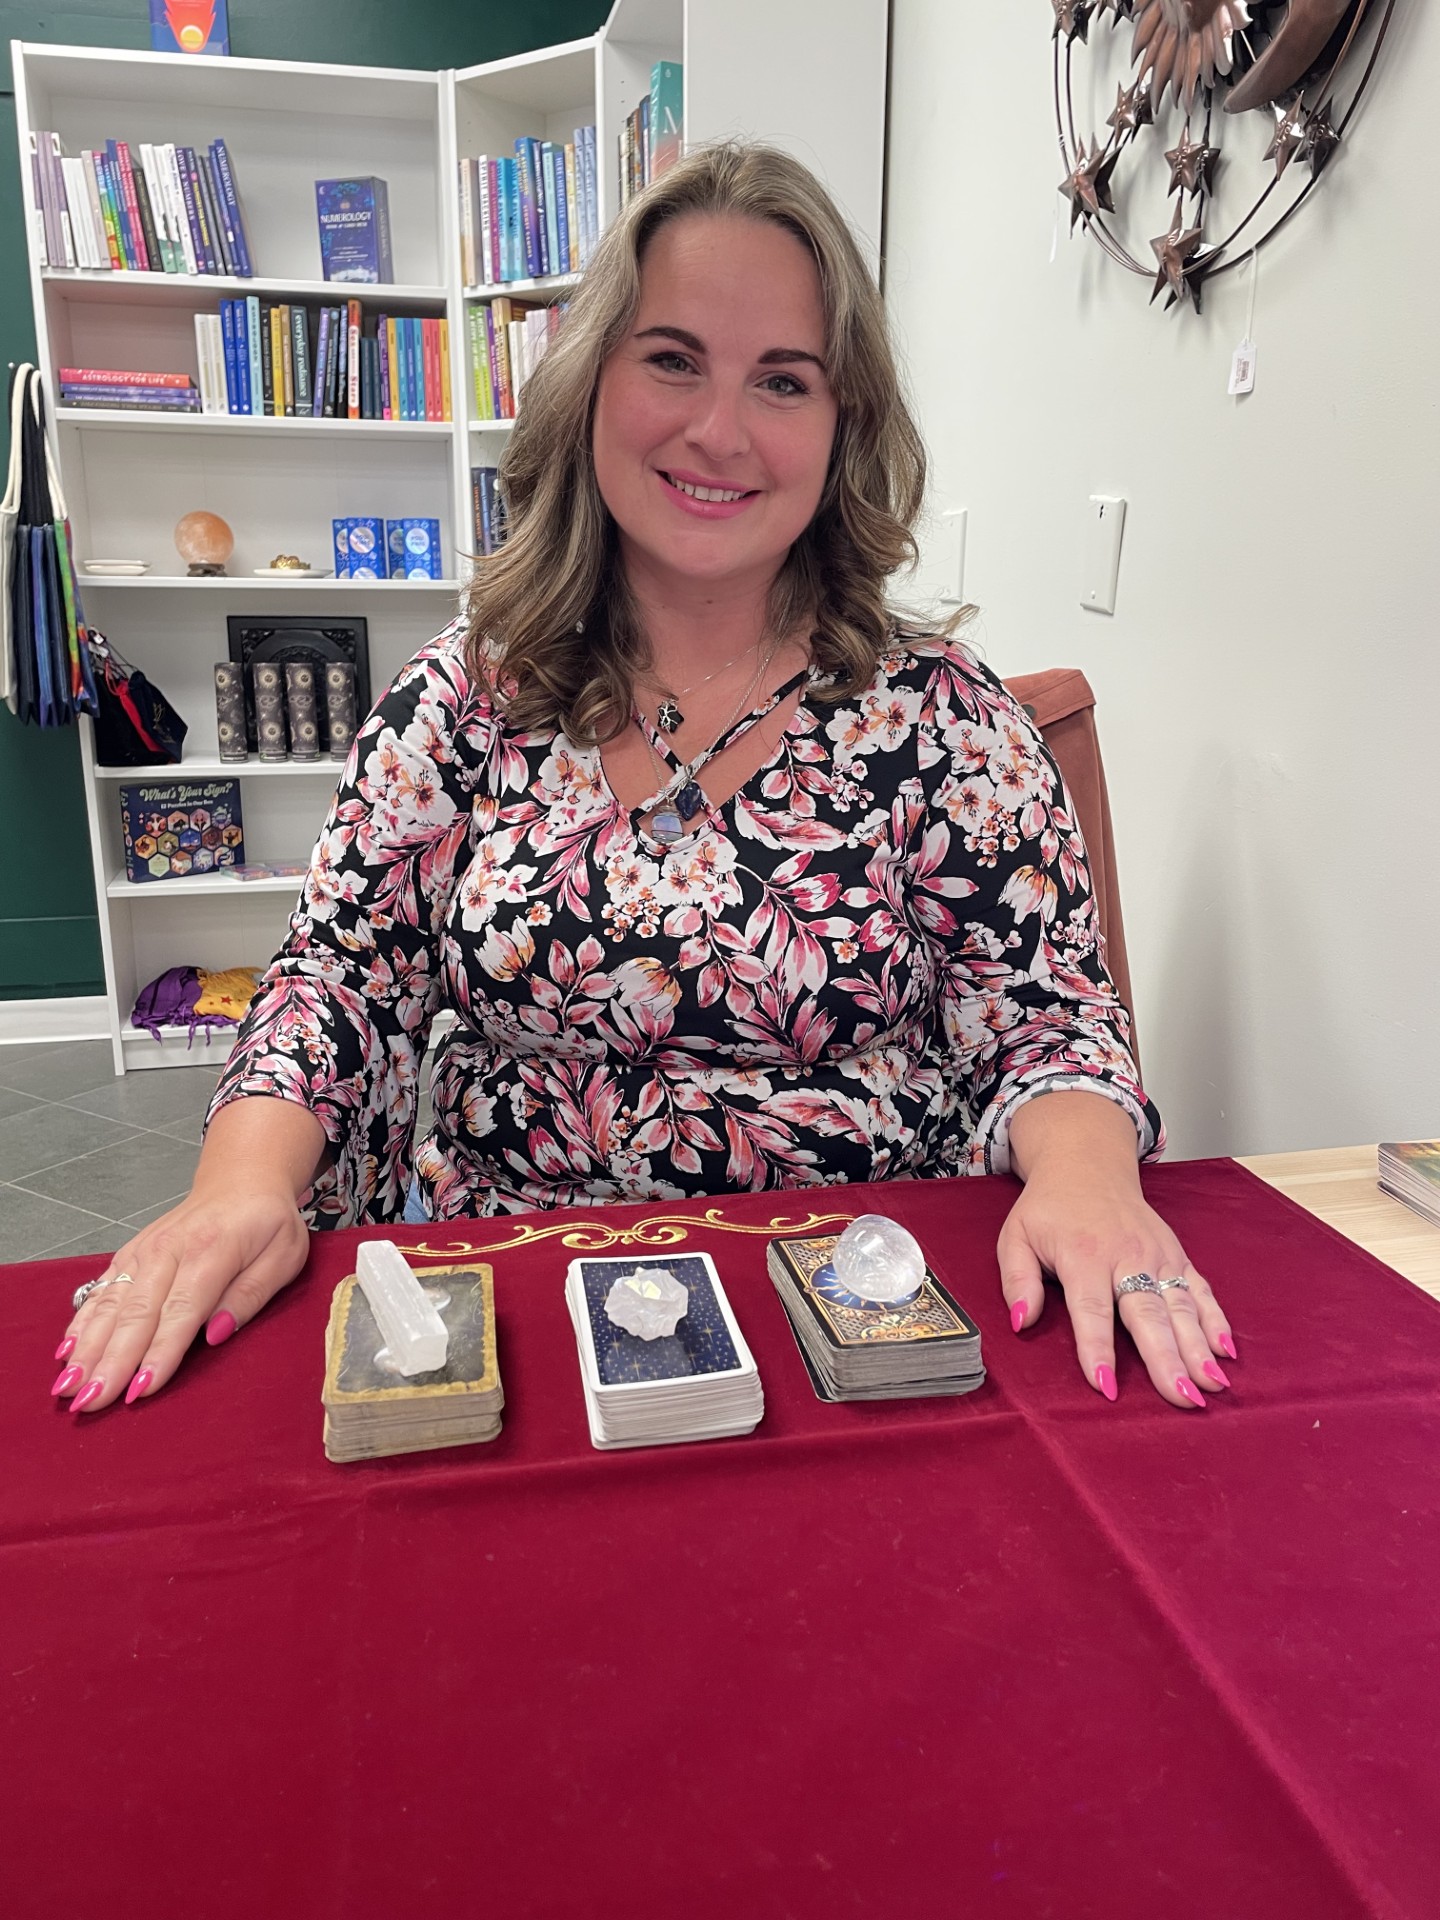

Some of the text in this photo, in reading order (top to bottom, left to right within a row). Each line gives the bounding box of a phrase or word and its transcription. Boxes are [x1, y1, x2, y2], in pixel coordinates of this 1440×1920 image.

[176, 149, 186, 170] LOVE
[182, 181, 196, 220] NUMBERS
[216, 146, 236, 206] NUMEROLOGY
[320, 211, 372, 223] NUMEROLOGY
[293, 314, 309, 397] everyday radiance
[82, 374, 165, 385] ASTROLOGY FOR LIFE
[139, 782, 233, 802] What's Your Sign?
